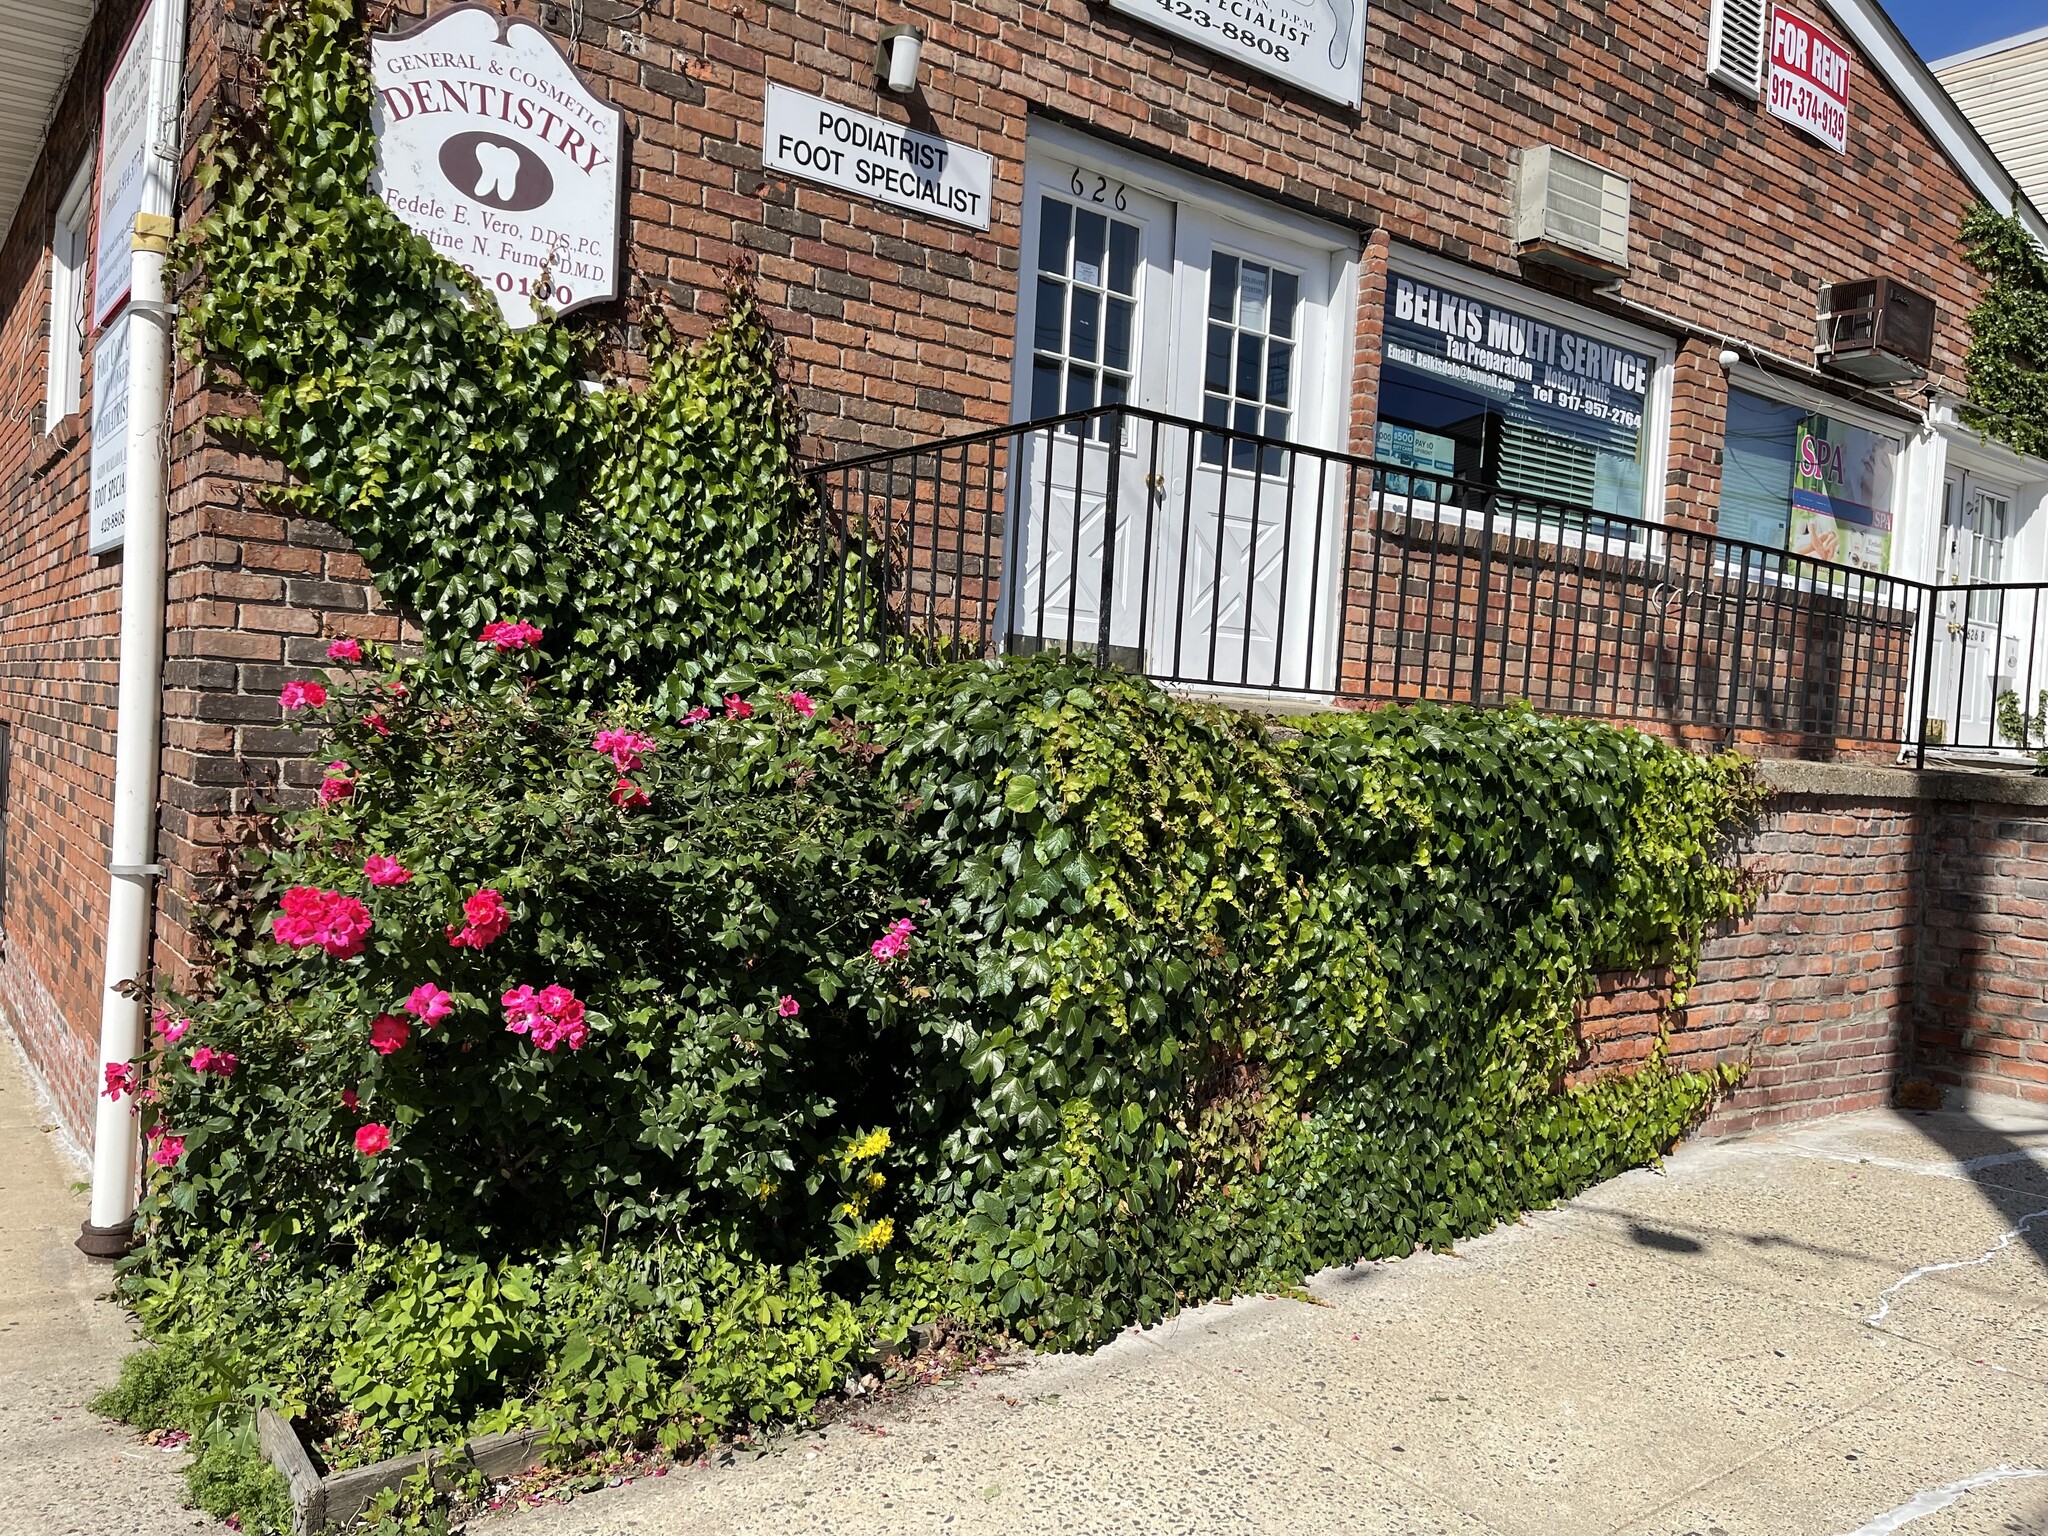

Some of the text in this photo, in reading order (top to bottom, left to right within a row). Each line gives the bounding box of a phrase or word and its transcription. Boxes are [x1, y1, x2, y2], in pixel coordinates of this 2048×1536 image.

[1156, 0, 1290, 63] 423-8808
[1206, 0, 1310, 47] ECIALIST
[1281, 8, 1316, 33] D.P.M.
[1773, 16, 1848, 98] FOR RENT
[387, 52, 606, 135] GENERAL & COSMETIC
[1771, 73, 1845, 143] 917-374-9139
[379, 79, 612, 178] DENTISTRY
[818, 110, 949, 173] PODIATRIST
[778, 134, 982, 216] FOOT SPECIALIST
[1071, 166, 1127, 211] 626
[386, 187, 445, 220] Fedele
[452, 205, 471, 226] E.
[480, 211, 524, 241] Vero,
[411, 221, 464, 251] istine
[471, 234, 491, 257] N.
[559, 257, 606, 283] D.M.D.
[1387, 342, 1415, 366] Email:
[1394, 277, 1647, 395] BELKIS MULTI SERVICE
[1446, 334, 1533, 382] Tax Preparation
[1532, 384, 1642, 429] Tel 917-957-2764
[1543, 365, 1611, 406] Notary Public
[1393, 430, 1414, 444] $500
[1415, 438, 1426, 449] PAY
[1800, 434, 1845, 487] SPA
[1874, 511, 1892, 531] SPA
